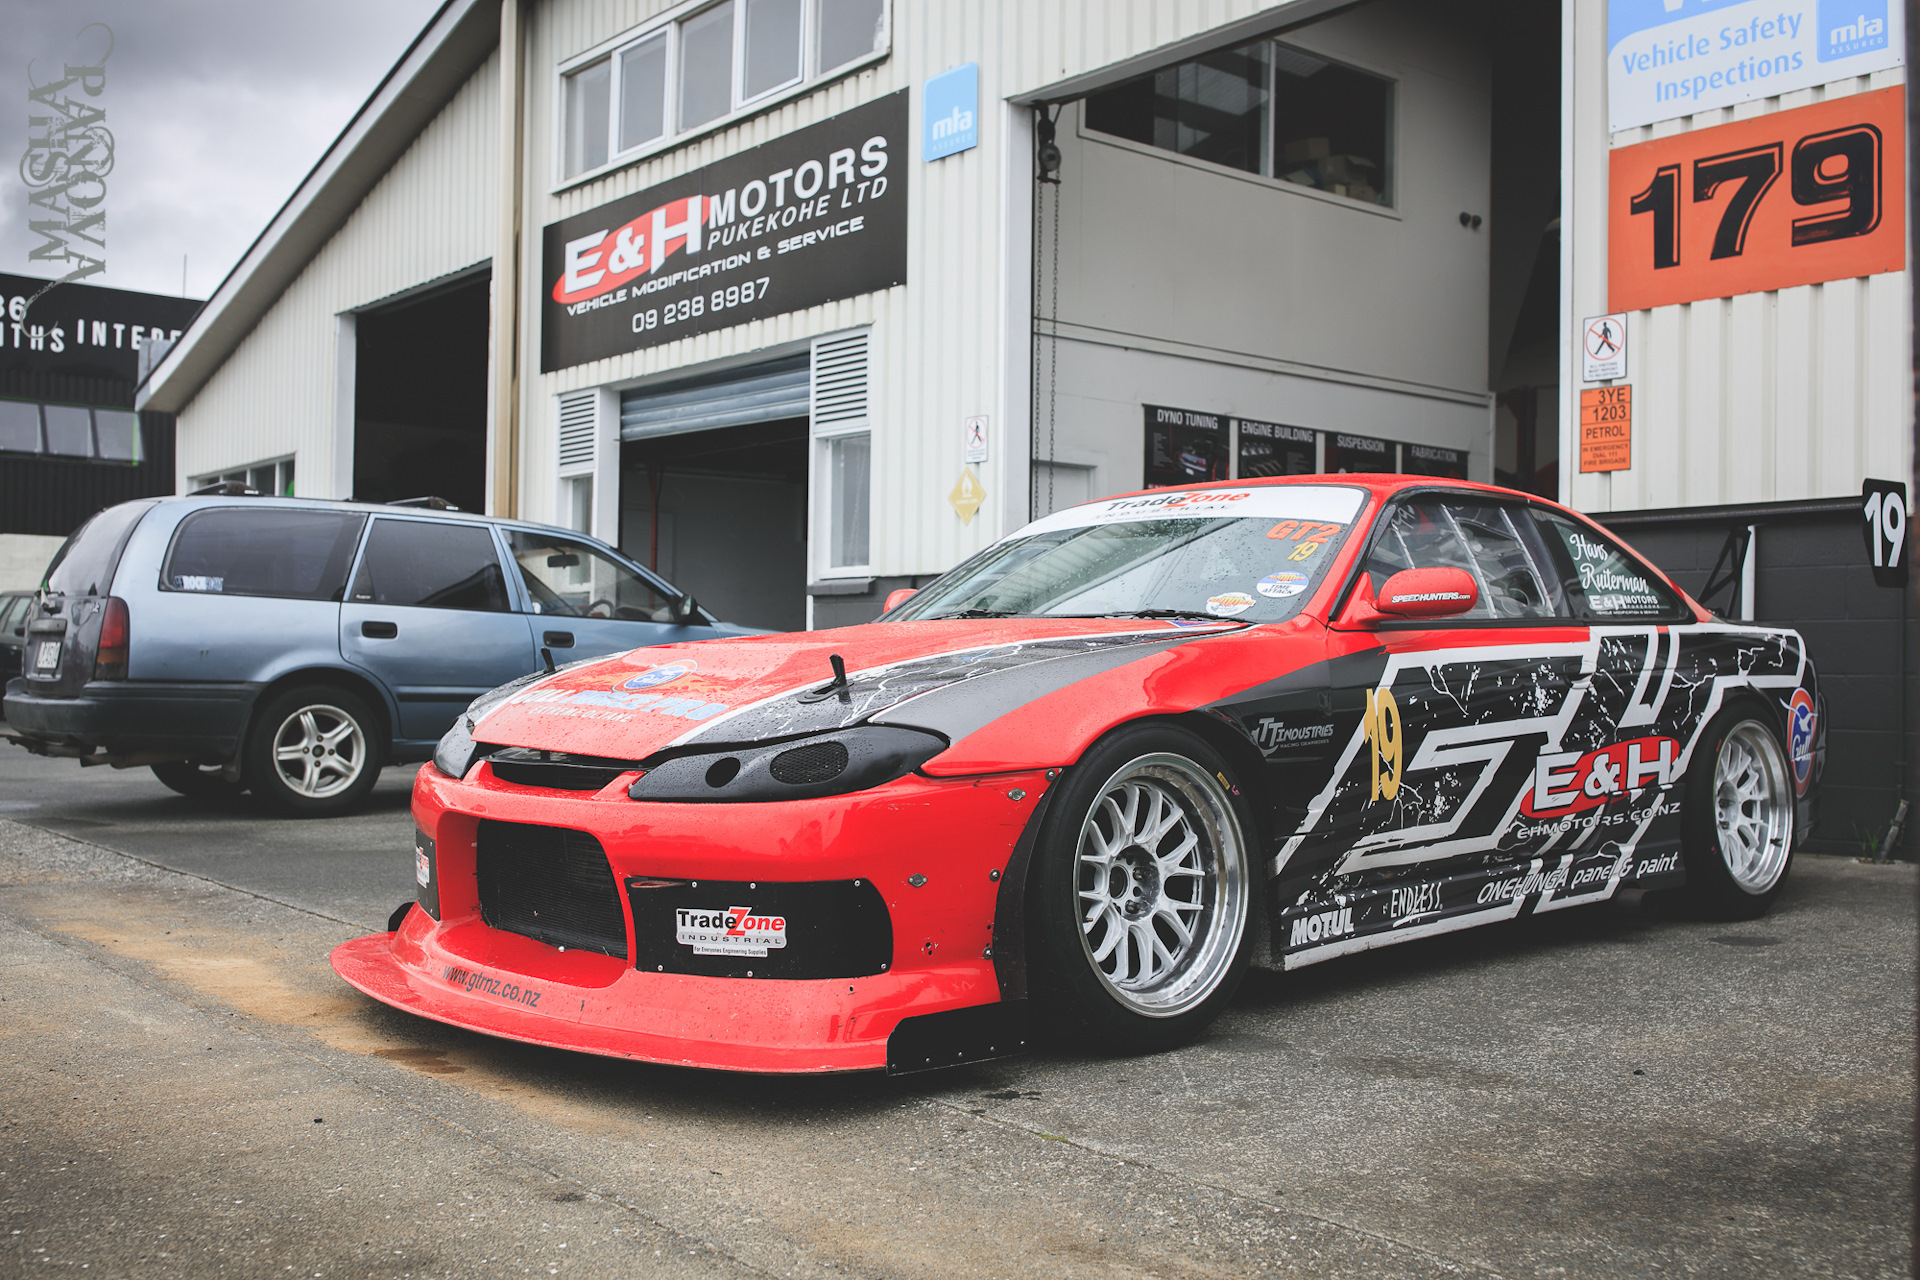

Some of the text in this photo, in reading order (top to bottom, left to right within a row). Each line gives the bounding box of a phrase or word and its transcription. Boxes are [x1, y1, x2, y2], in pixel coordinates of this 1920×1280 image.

[1622, 12, 1803, 75] Vehicle Safety
[1831, 14, 1883, 45] mta
[1831, 36, 1883, 56] ASSURED
[1655, 51, 1804, 103] Inspections
[933, 105, 973, 141] mta
[1630, 123, 1883, 270] 179
[564, 135, 888, 294] E&H MOTORS
[707, 176, 888, 251] PUKEKOHE LTD
[567, 216, 865, 316] VEHICLE MODIFICATION & SERVICE
[0, 295, 27, 322] 6
[632, 277, 770, 334] 09 238 8987
[1598, 387, 1626, 405] 3YE
[1157, 409, 1219, 430] DYNO TUNING
[1592, 405, 1626, 422] 1203
[1241, 421, 1313, 443] ENGINE BUILDING
[1336, 434, 1385, 453] SUSPENSION
[1586, 425, 1625, 440] PETROL
[1411, 445, 1458, 462] FABRICATION
[1266, 520, 1341, 544] GT2
[1864, 491, 1906, 568] 19
[1287, 541, 1319, 562] 19
[1569, 533, 1608, 561] Hans
[1580, 562, 1649, 594] Ruiterman
[1391, 592, 1471, 603] SPEEDHUNTERS.com
[1588, 594, 1658, 610] E&H MOTORS
[581, 709, 637, 723] OCTANE
[1363, 688, 1403, 802] 19
[1533, 739, 1674, 812] E&H
[1517, 802, 1681, 840] EHMOTORS.CO.NZ
[1477, 851, 1679, 904] ONEHUNGA panel & paint
[1391, 881, 1442, 919] ENDLESS
[677, 908, 785, 936] TradeZone
[1290, 907, 1355, 947] MOTUL
[682, 934, 781, 945] INDUSTRIAL
[722, 947, 747, 955] Engineering
[748, 948, 767, 956] Supplies
[442, 966, 541, 1008] www.gtrnz.co.nz
